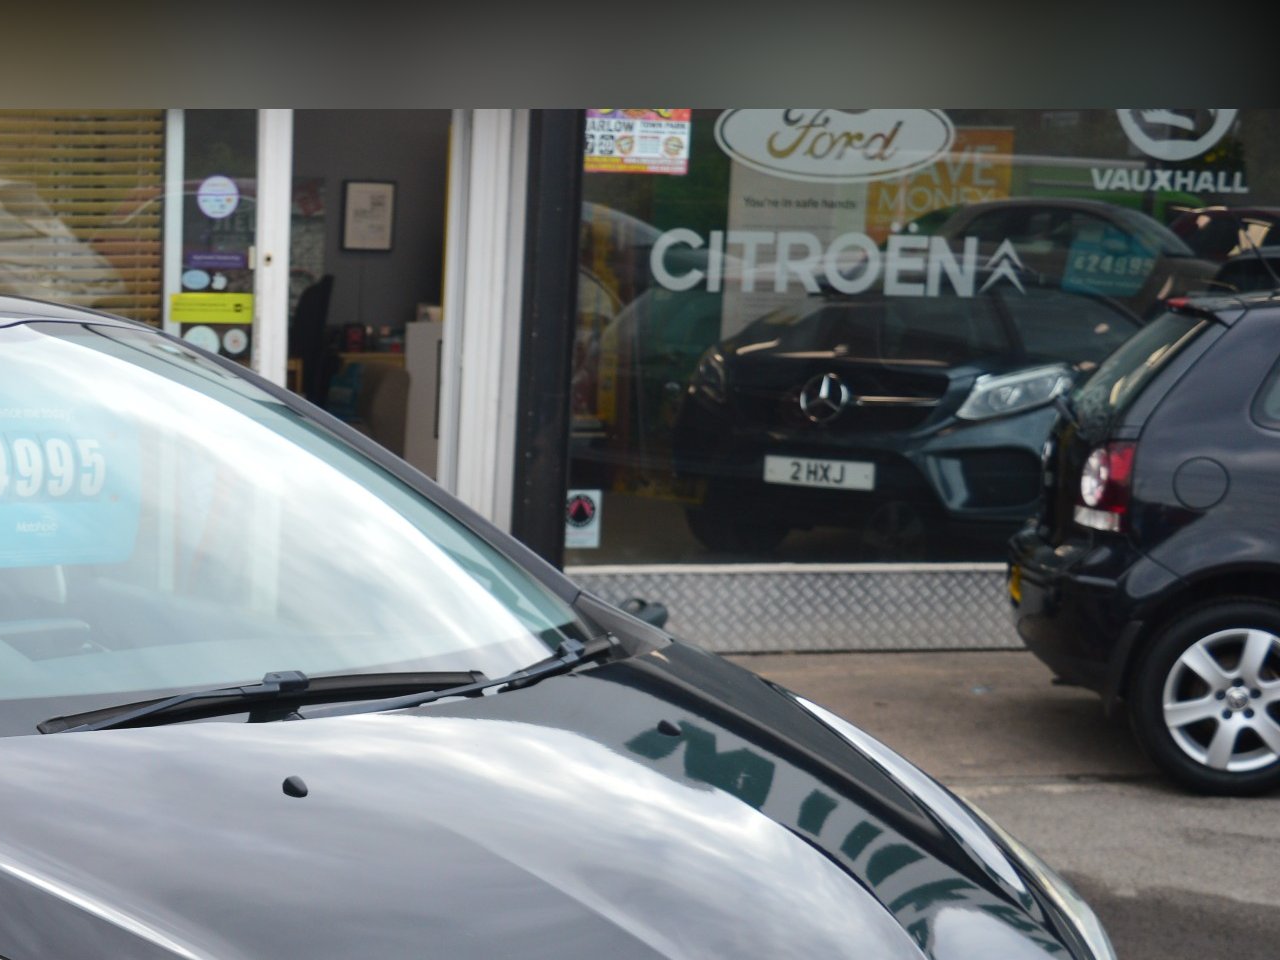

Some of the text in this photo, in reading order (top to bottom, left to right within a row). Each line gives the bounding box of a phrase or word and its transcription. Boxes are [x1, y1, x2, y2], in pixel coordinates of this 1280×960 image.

[766, 108, 904, 161] Ford
[884, 143, 998, 187] AVE
[1090, 167, 1249, 194] VAUXHALL
[650, 221, 979, 298] CITROËN
[790, 461, 846, 484] 2 HXJ
